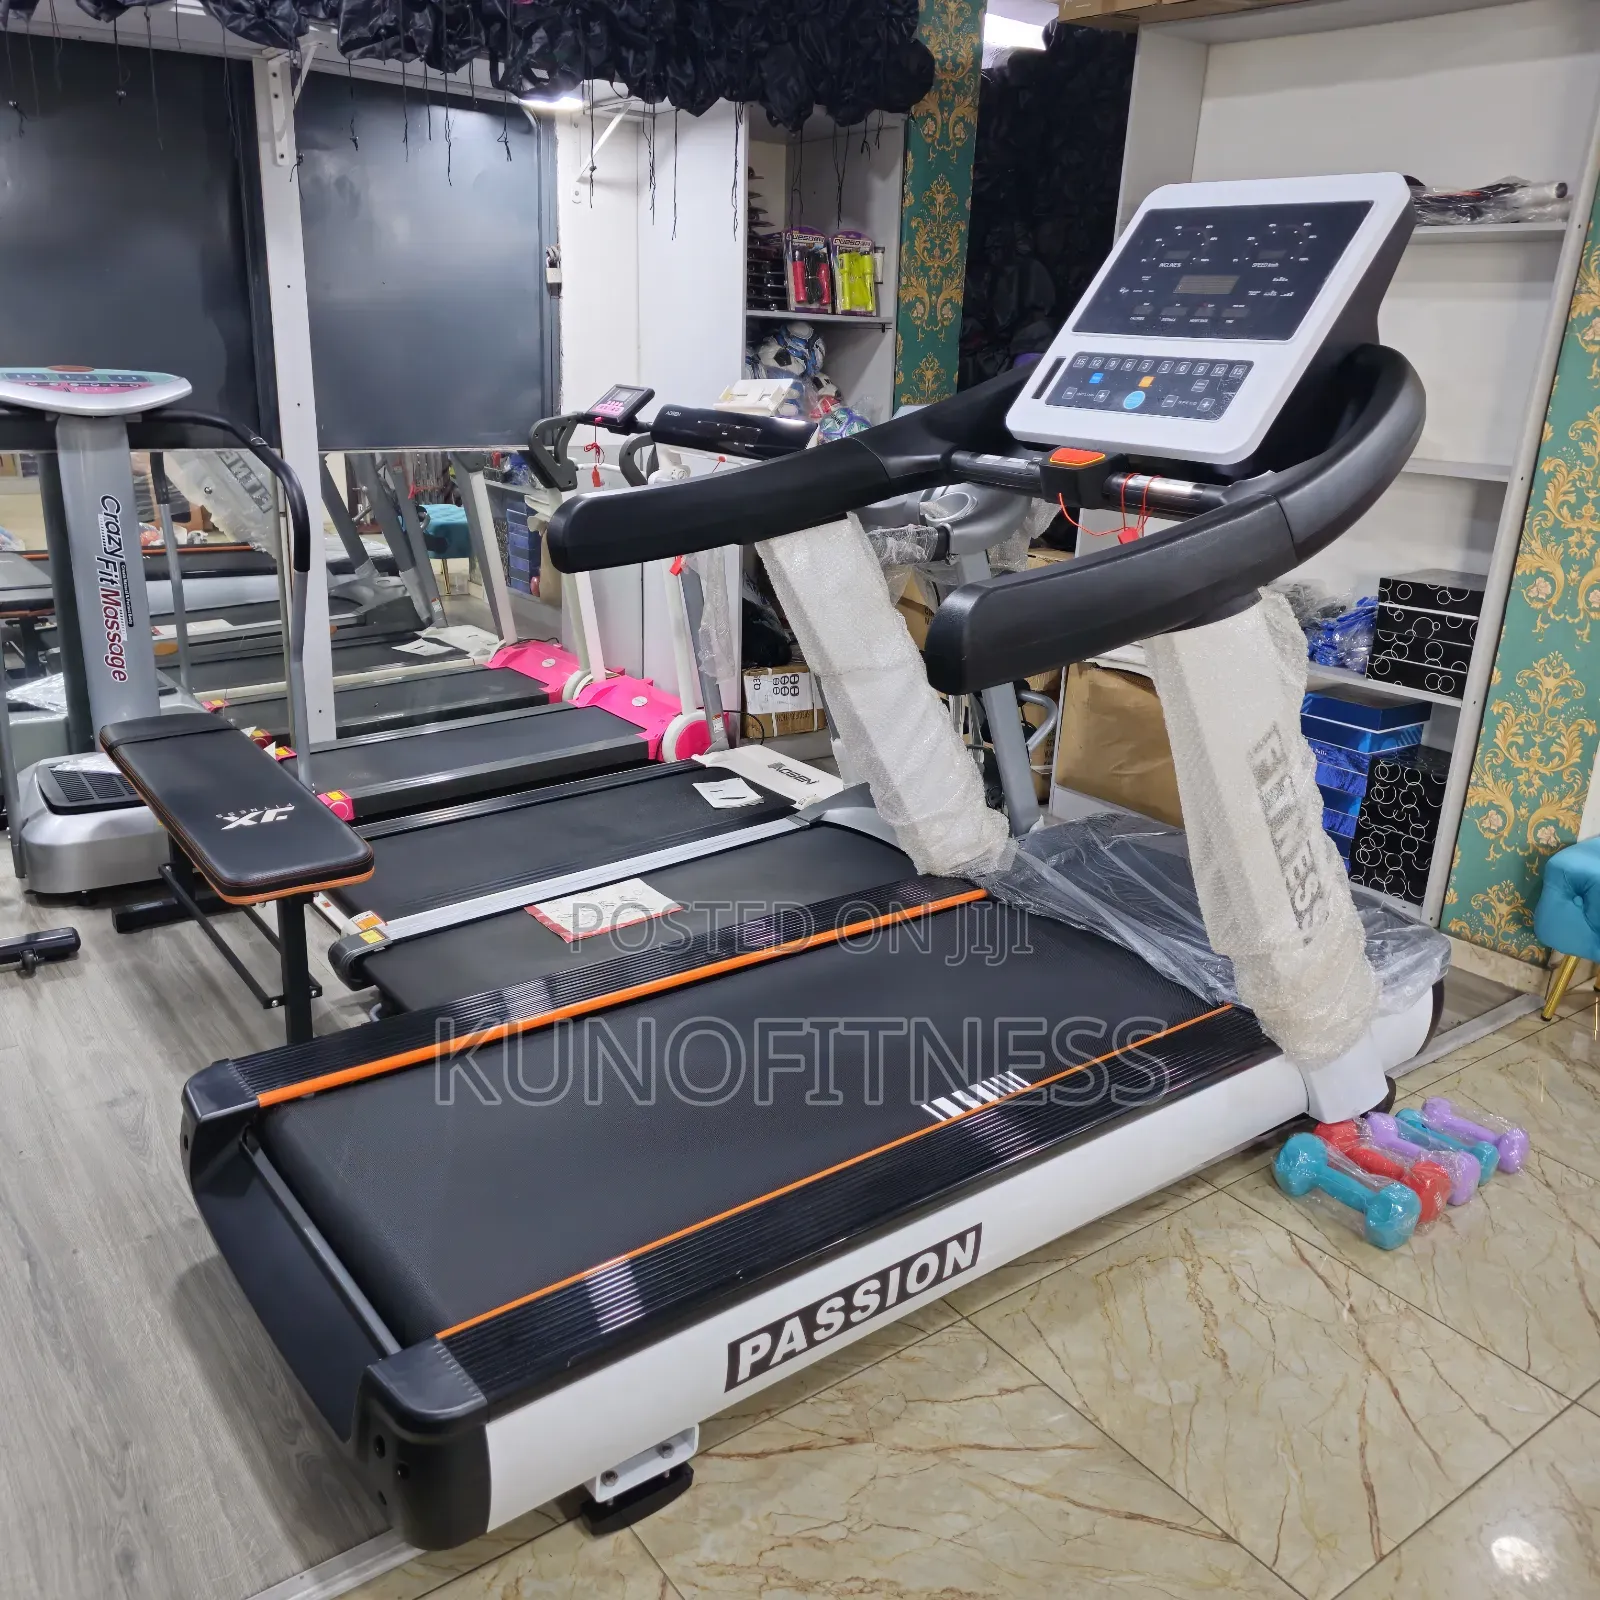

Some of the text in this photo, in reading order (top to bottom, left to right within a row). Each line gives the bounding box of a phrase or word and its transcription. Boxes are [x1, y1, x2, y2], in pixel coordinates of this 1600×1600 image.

[1214, 366, 1225, 374] 12
[1233, 367, 1243, 375] 15
[95, 494, 128, 683] Crazy Fit Massage
[735, 1229, 977, 1384] PASSION
